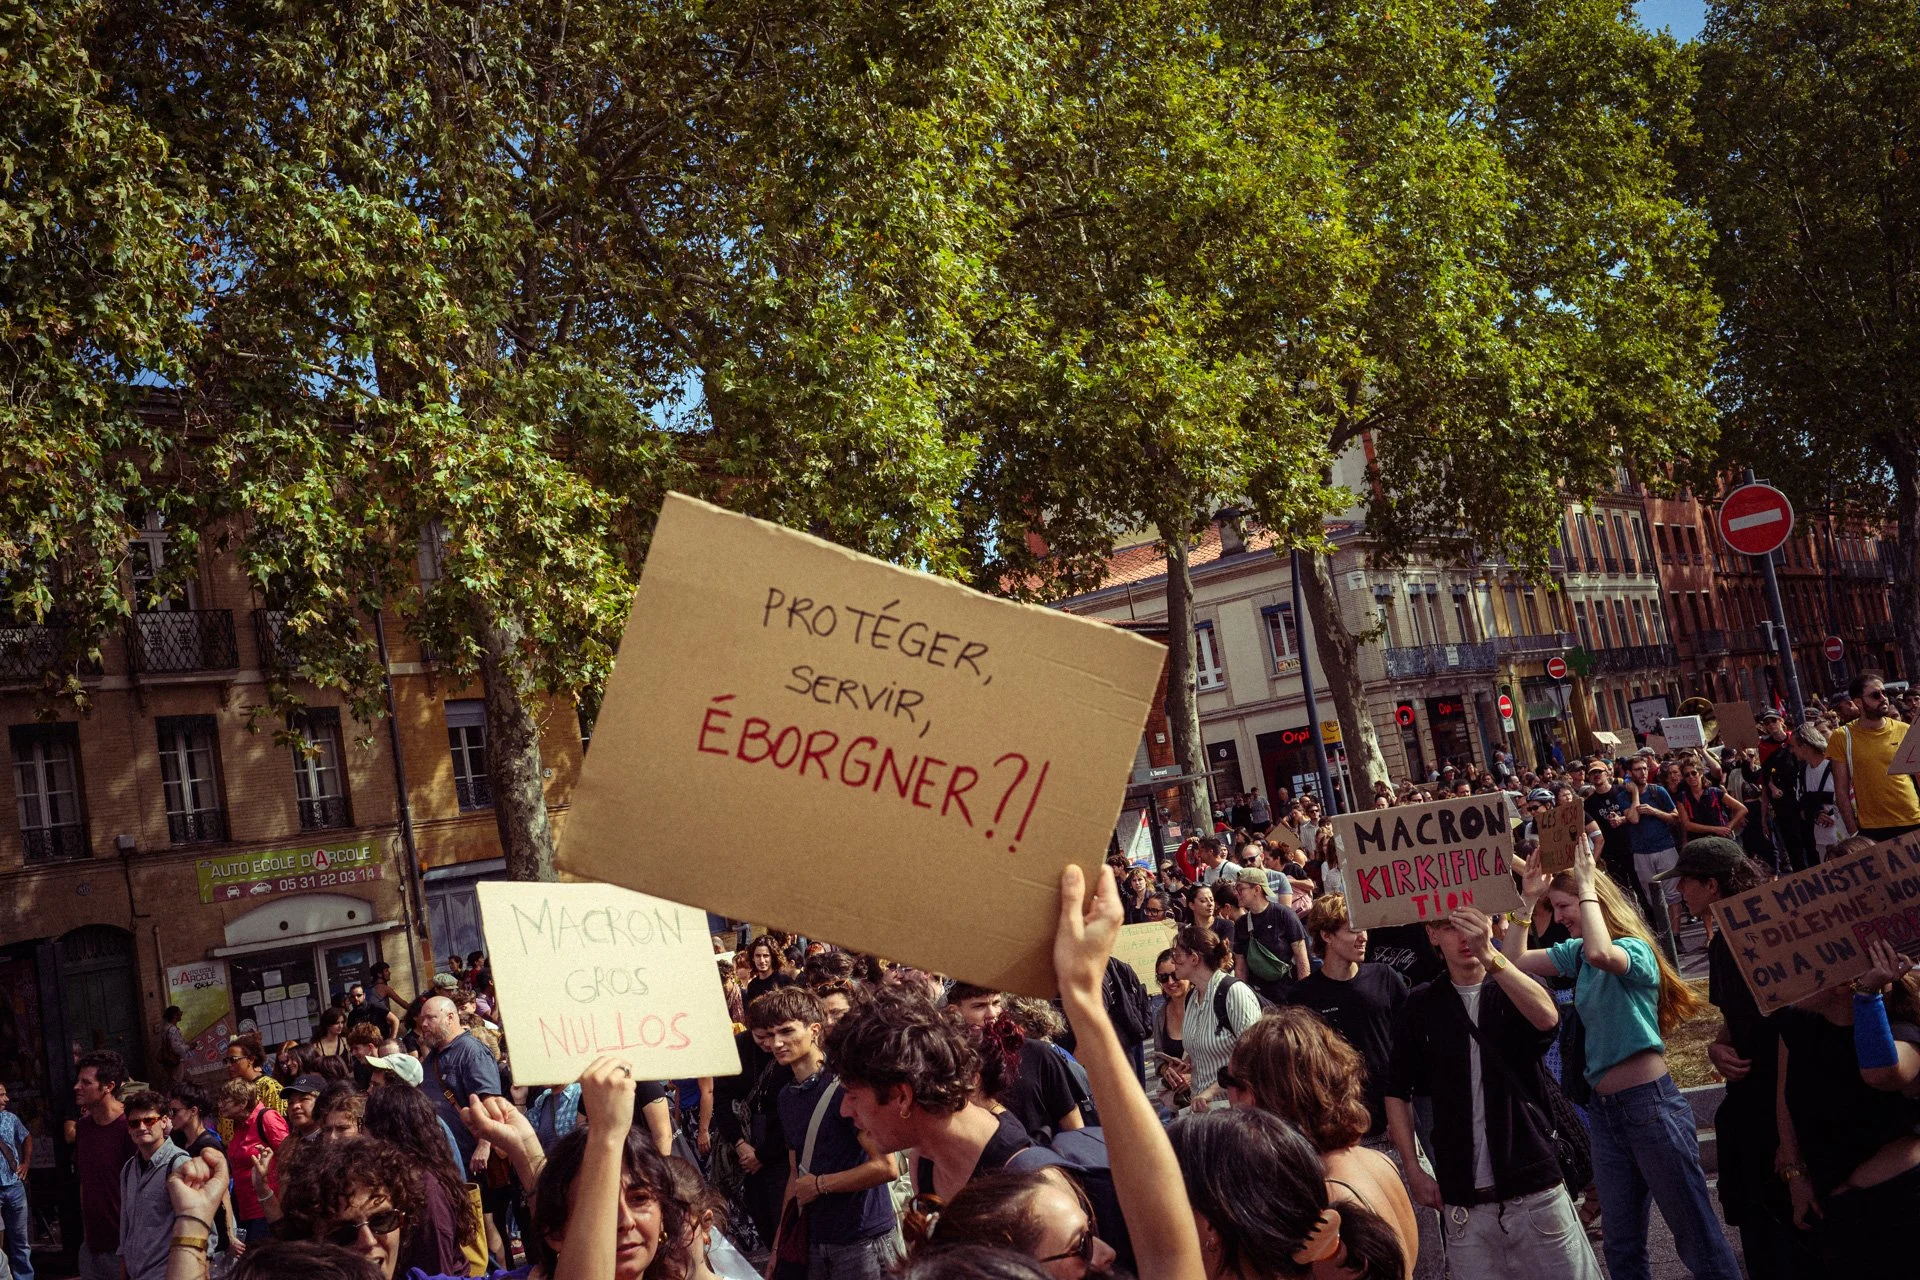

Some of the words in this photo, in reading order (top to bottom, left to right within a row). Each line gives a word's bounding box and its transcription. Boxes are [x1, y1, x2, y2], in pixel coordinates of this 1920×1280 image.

[763, 586, 993, 686] PROTÉGER,
[1282, 727, 1310, 744] Orpi
[1354, 801, 1507, 855] MACRON
[210, 861, 250, 879] AUTO
[252, 856, 296, 873] ECOLE
[300, 846, 372, 869] D'ARCOLE
[279, 878, 297, 892] 05
[300, 876, 316, 890] 31
[320, 873, 337, 887] 22
[339, 870, 356, 884] 03
[360, 868, 376, 881] 14
[1357, 846, 1508, 904] KIRKIFICA
[1723, 895, 1772, 931] LE
[1886, 848, 1907, 874] A
[510, 898, 683, 956] MACRON
[172, 970, 217, 986] D'ARCOLE
[565, 966, 649, 1004] GROS
[1752, 962, 1788, 988] ON
[1792, 951, 1814, 976] A
[1815, 937, 1858, 966] UN
[538, 1012, 691, 1058] NULLOS
